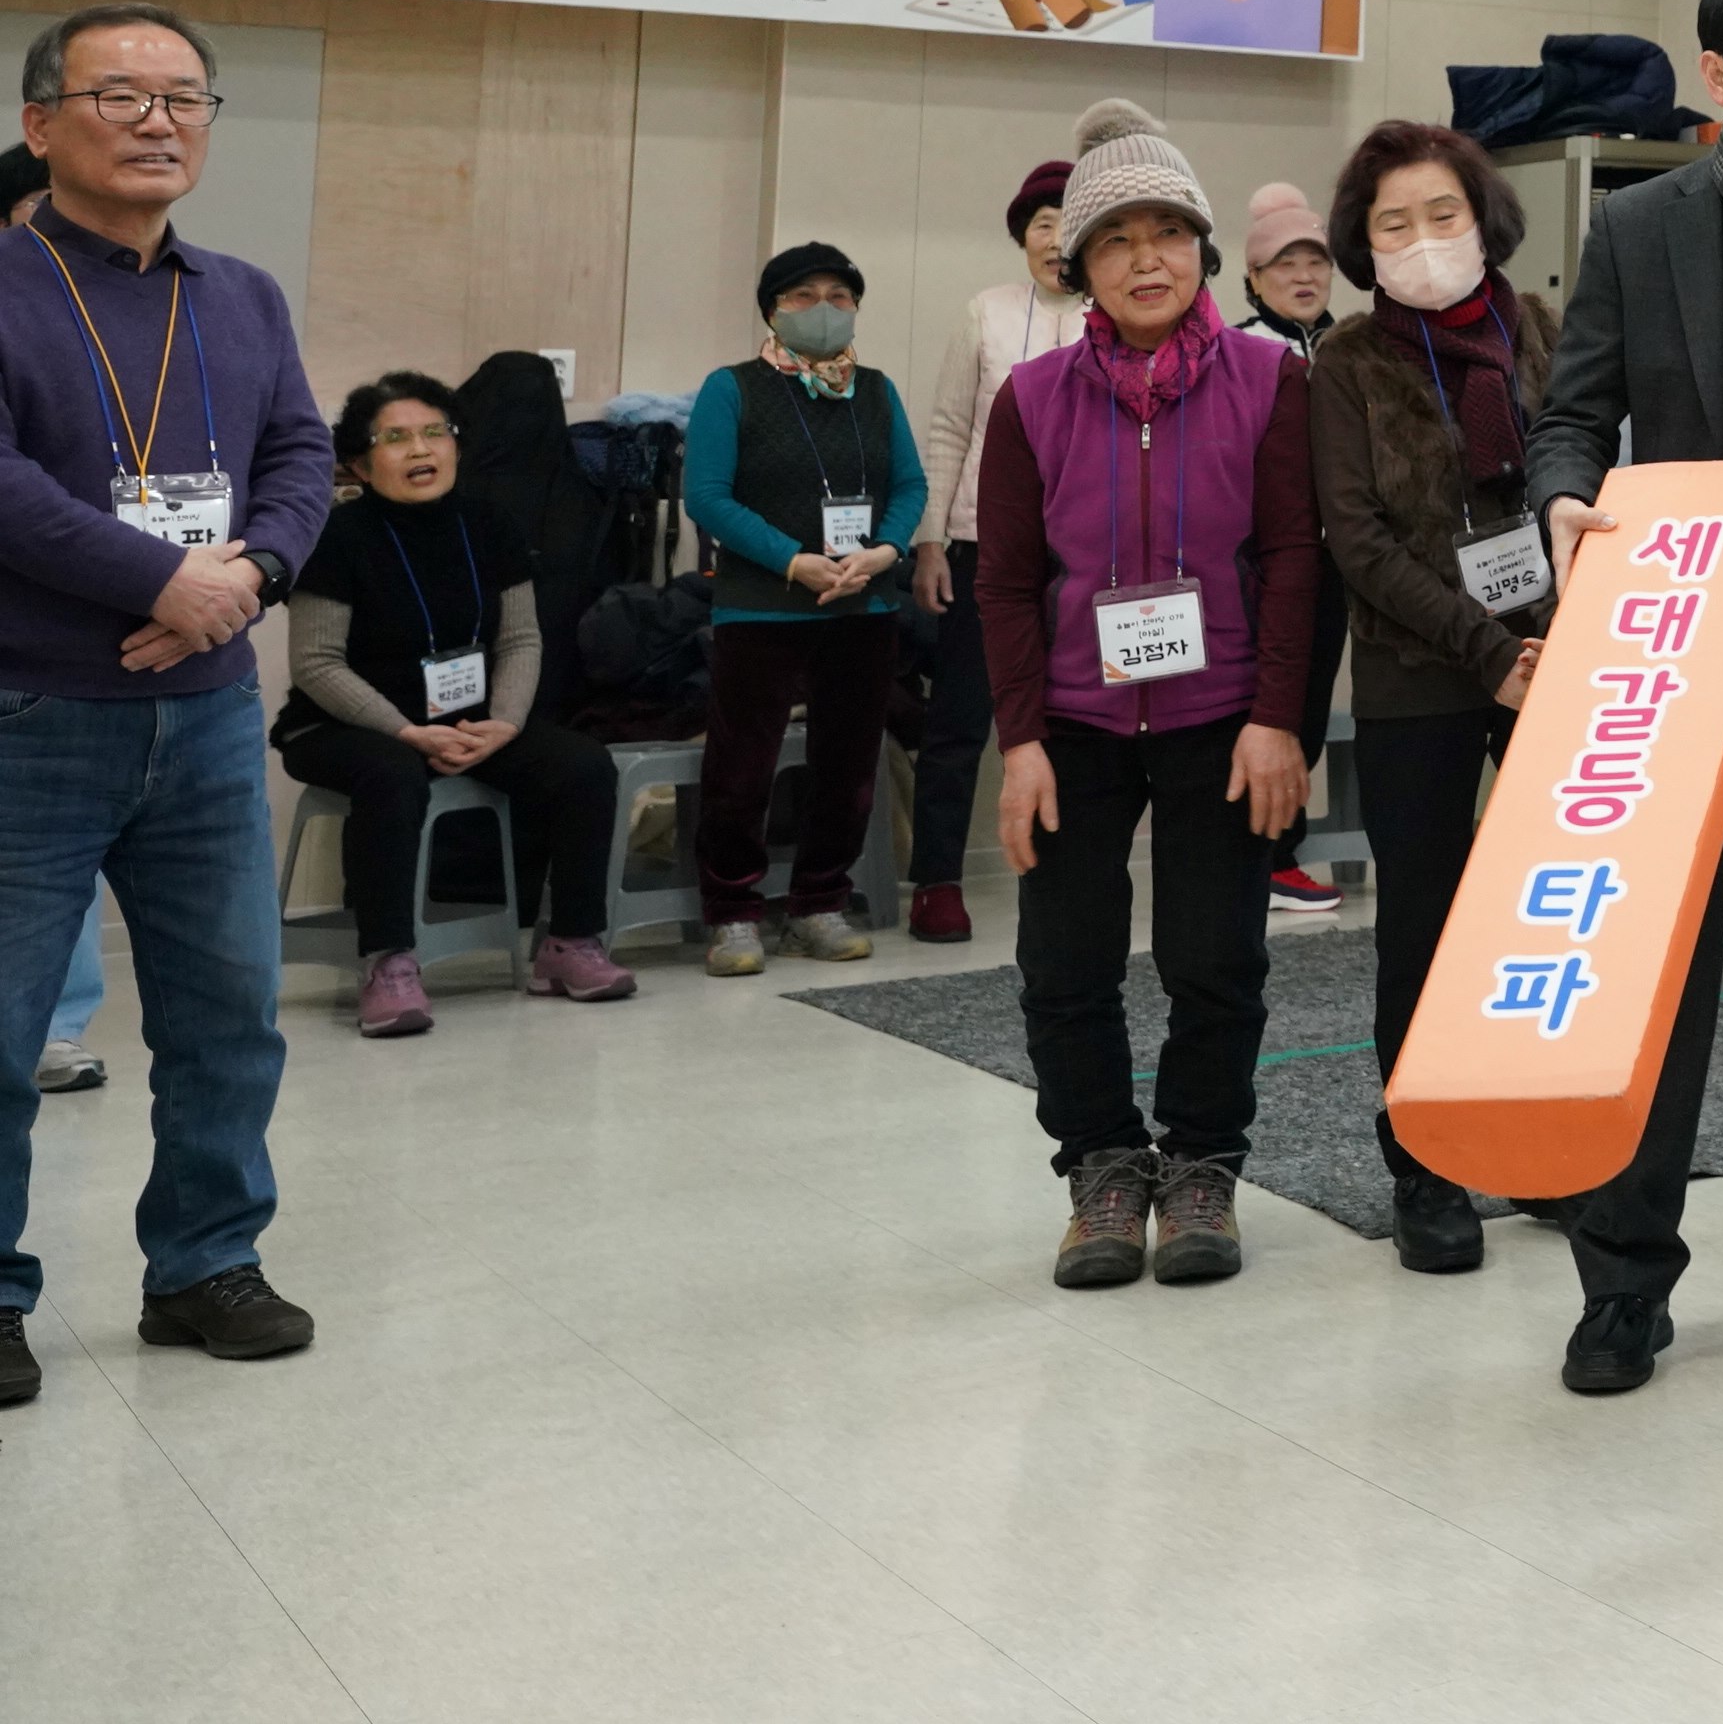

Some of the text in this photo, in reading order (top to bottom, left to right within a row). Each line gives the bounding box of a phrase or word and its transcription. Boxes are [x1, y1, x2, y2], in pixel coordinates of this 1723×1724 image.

[1481, 570, 1540, 602] 김명숙
[1119, 639, 1189, 666] 김점자
[1494, 524, 1721, 1030] 세대갈등 타파
